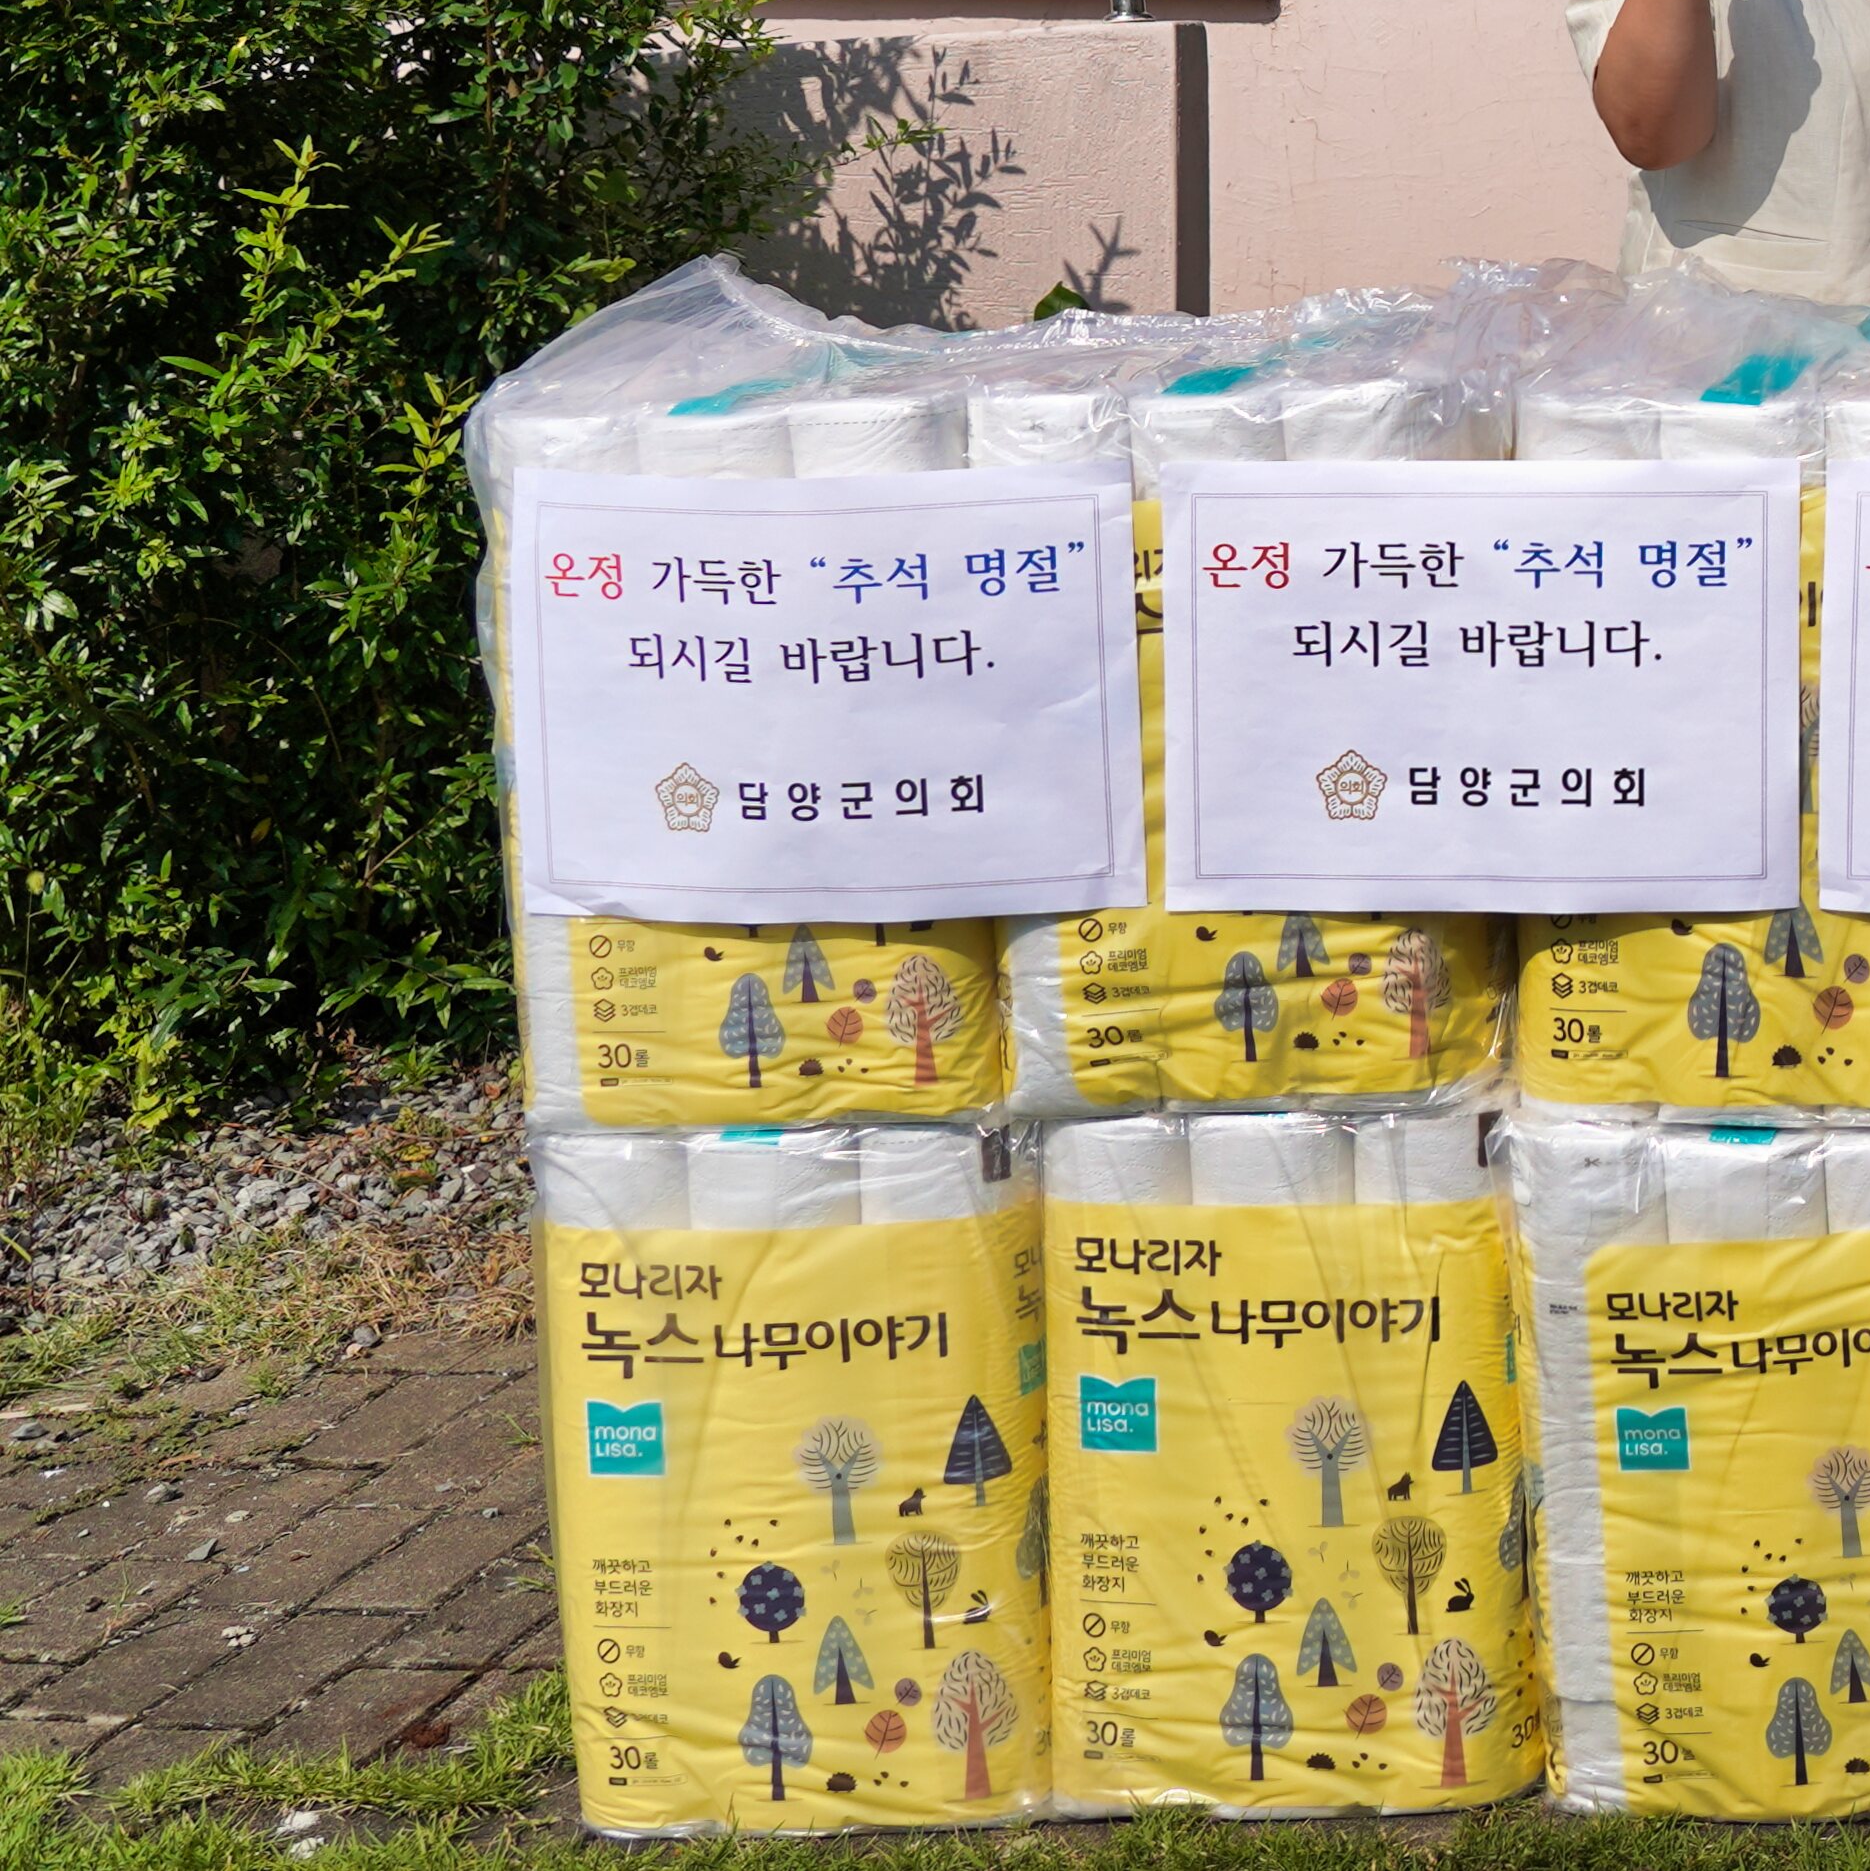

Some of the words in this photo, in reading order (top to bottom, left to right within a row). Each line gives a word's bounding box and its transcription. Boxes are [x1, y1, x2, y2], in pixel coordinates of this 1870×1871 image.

[545, 553, 623, 600] 온정
[652, 556, 781, 605] 가득한
[810, 553, 928, 604] “추석
[965, 541, 1084, 596] 명절”
[1203, 542, 1289, 589] 온정
[1323, 541, 1464, 589] 가득한
[1494, 540, 1603, 589] “추석
[1639, 537, 1752, 588] 명절”
[629, 633, 752, 683] 되시길
[780, 630, 994, 684] 바랍니다.
[1293, 620, 1429, 667] 되시길
[1459, 620, 1661, 668] 바랍니다.
[739, 774, 984, 822] 담양군의회
[1409, 767, 1645, 807] 담양군의회
[1075, 1237, 1222, 1277] 모나리자
[579, 1263, 722, 1300] 모나리자
[1076, 1286, 1200, 1355] 녹스
[1211, 1293, 1440, 1353] 나무이야기
[1607, 1290, 1739, 1322] 모나리자
[581, 1312, 704, 1379] 녹스
[714, 1312, 948, 1370] 나무이야기
[1609, 1333, 1723, 1390] 녹스
[595, 1426, 656, 1441] mona
[1625, 1429, 1684, 1440] mona
